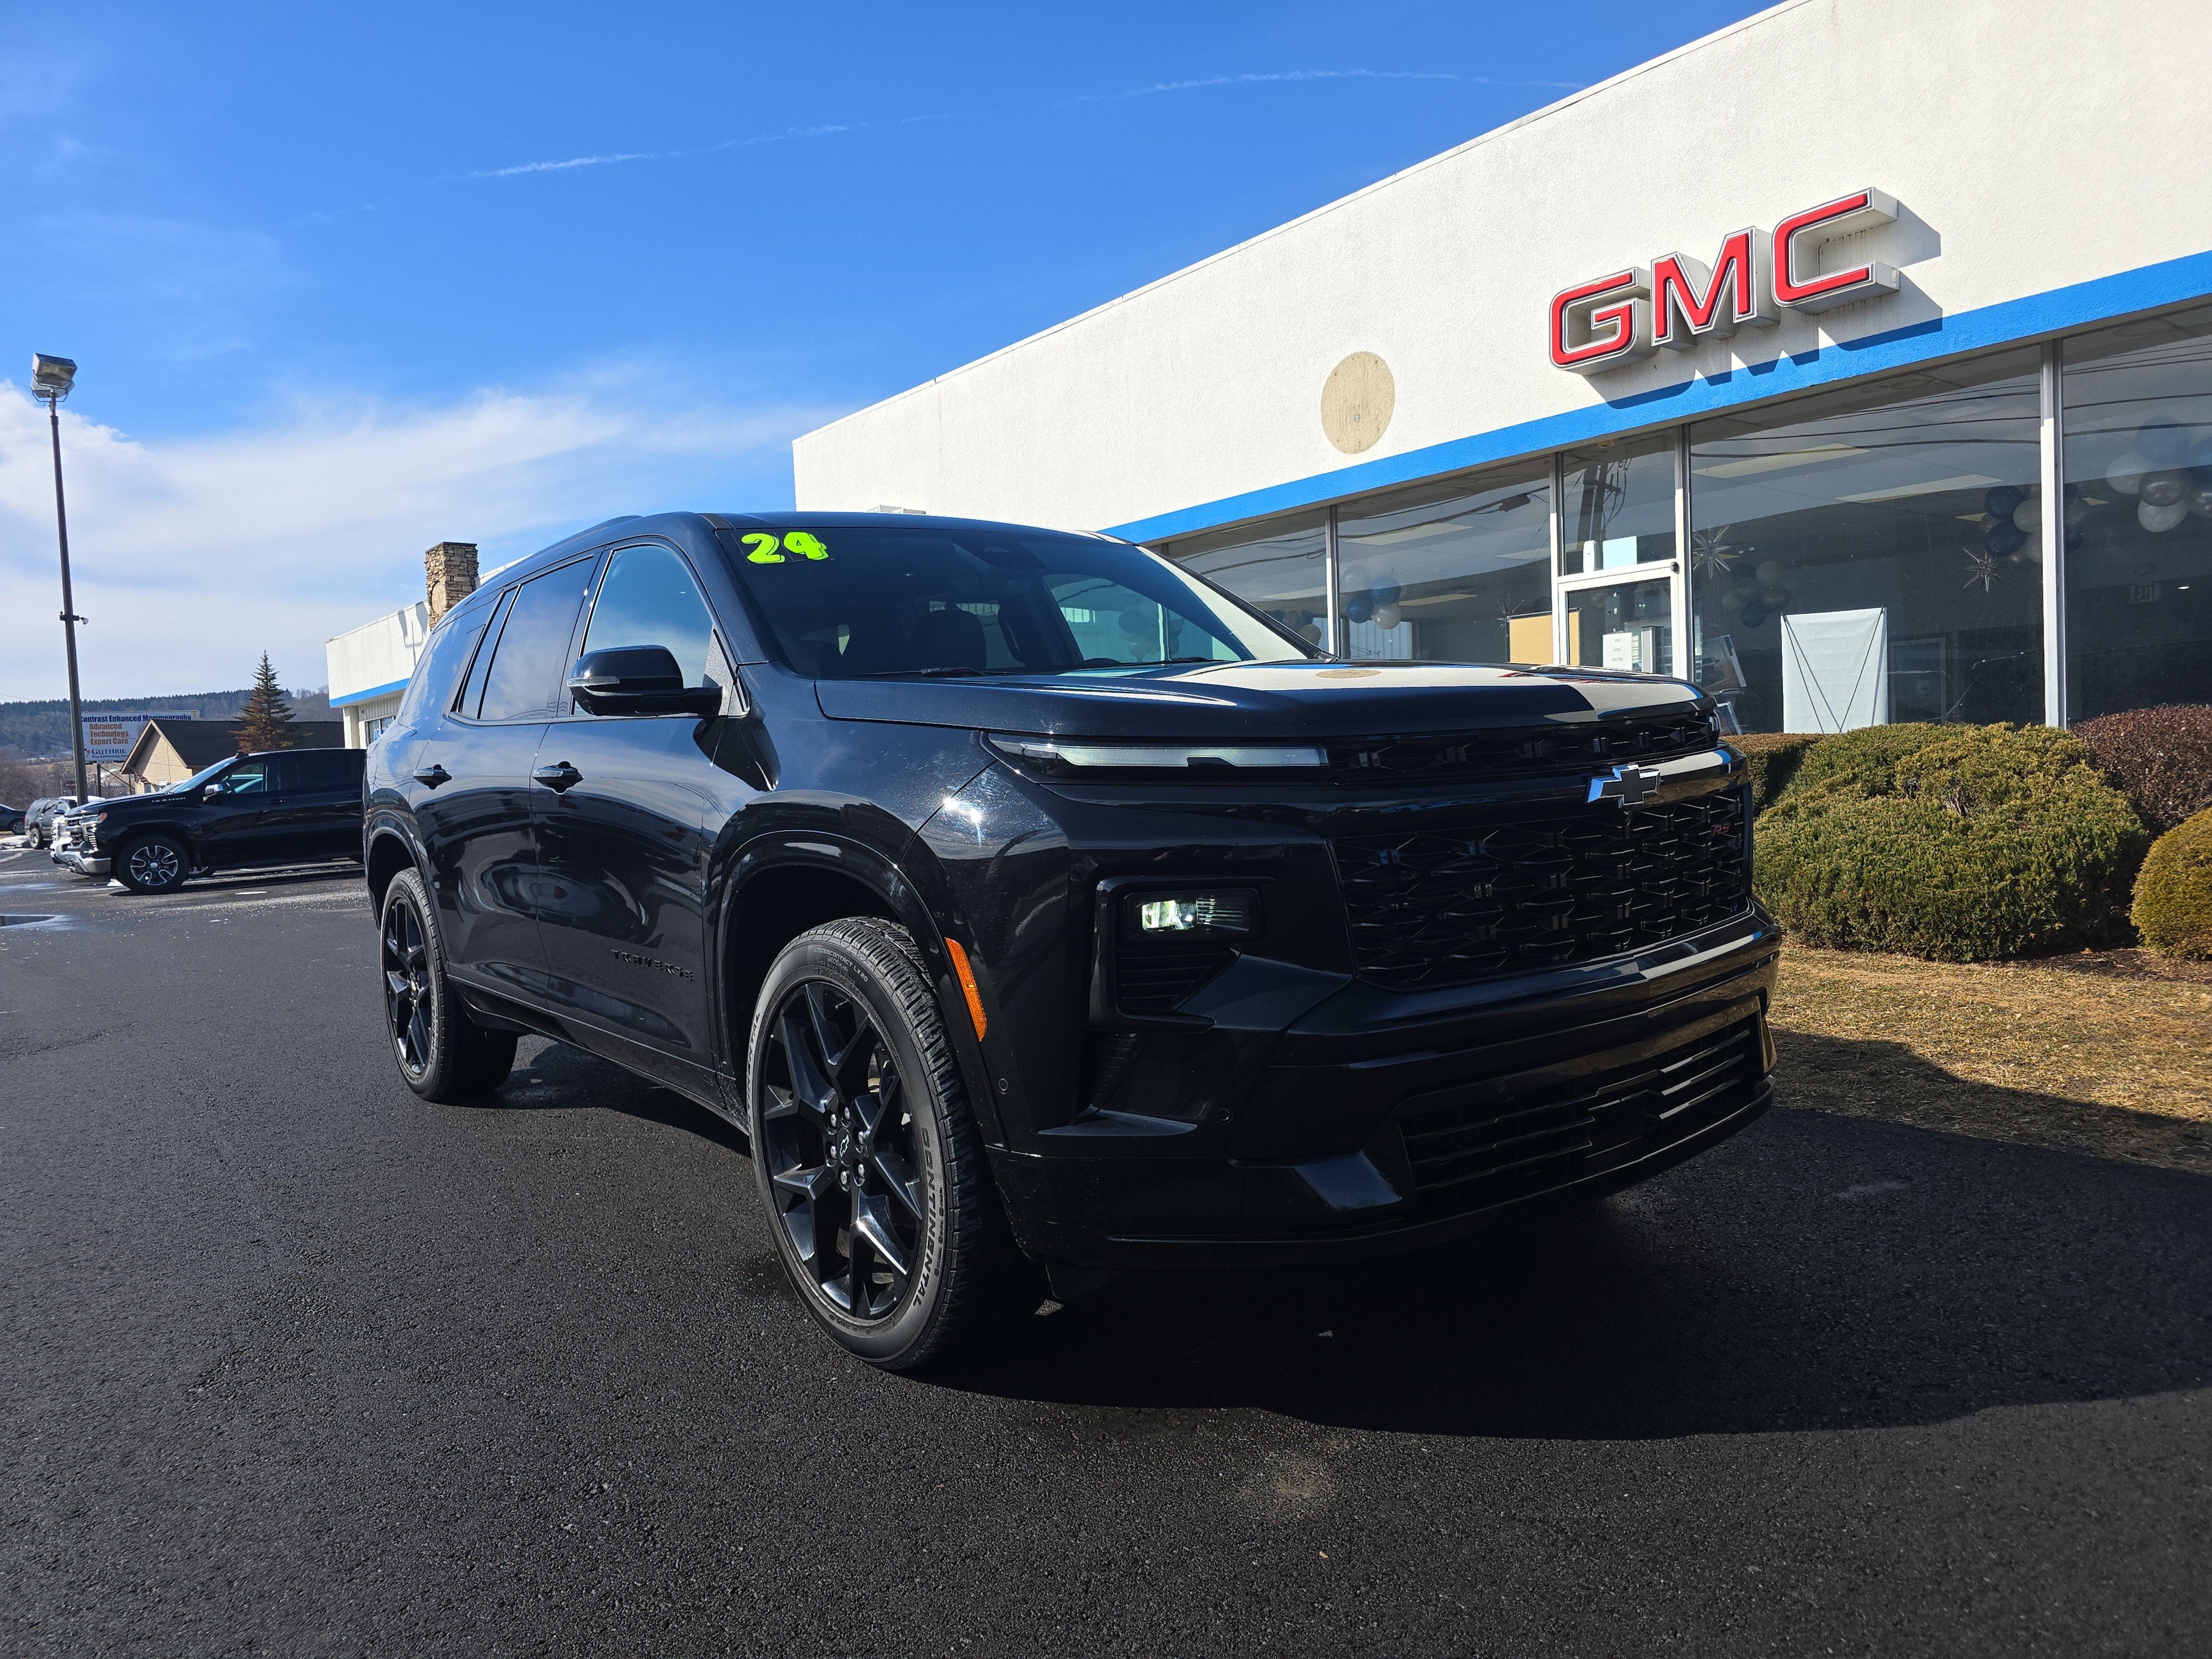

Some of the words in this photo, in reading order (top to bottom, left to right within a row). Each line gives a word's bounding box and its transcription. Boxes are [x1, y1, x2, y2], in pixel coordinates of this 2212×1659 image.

[1549, 187, 1879, 371] GMC
[741, 532, 829, 564] 24
[1712, 821, 1731, 836] RS
[611, 949, 694, 981] TRAVERSE
[814, 947, 853, 967] CROSSCONTACT
[913, 1127, 936, 1307] CONTINENTAL
